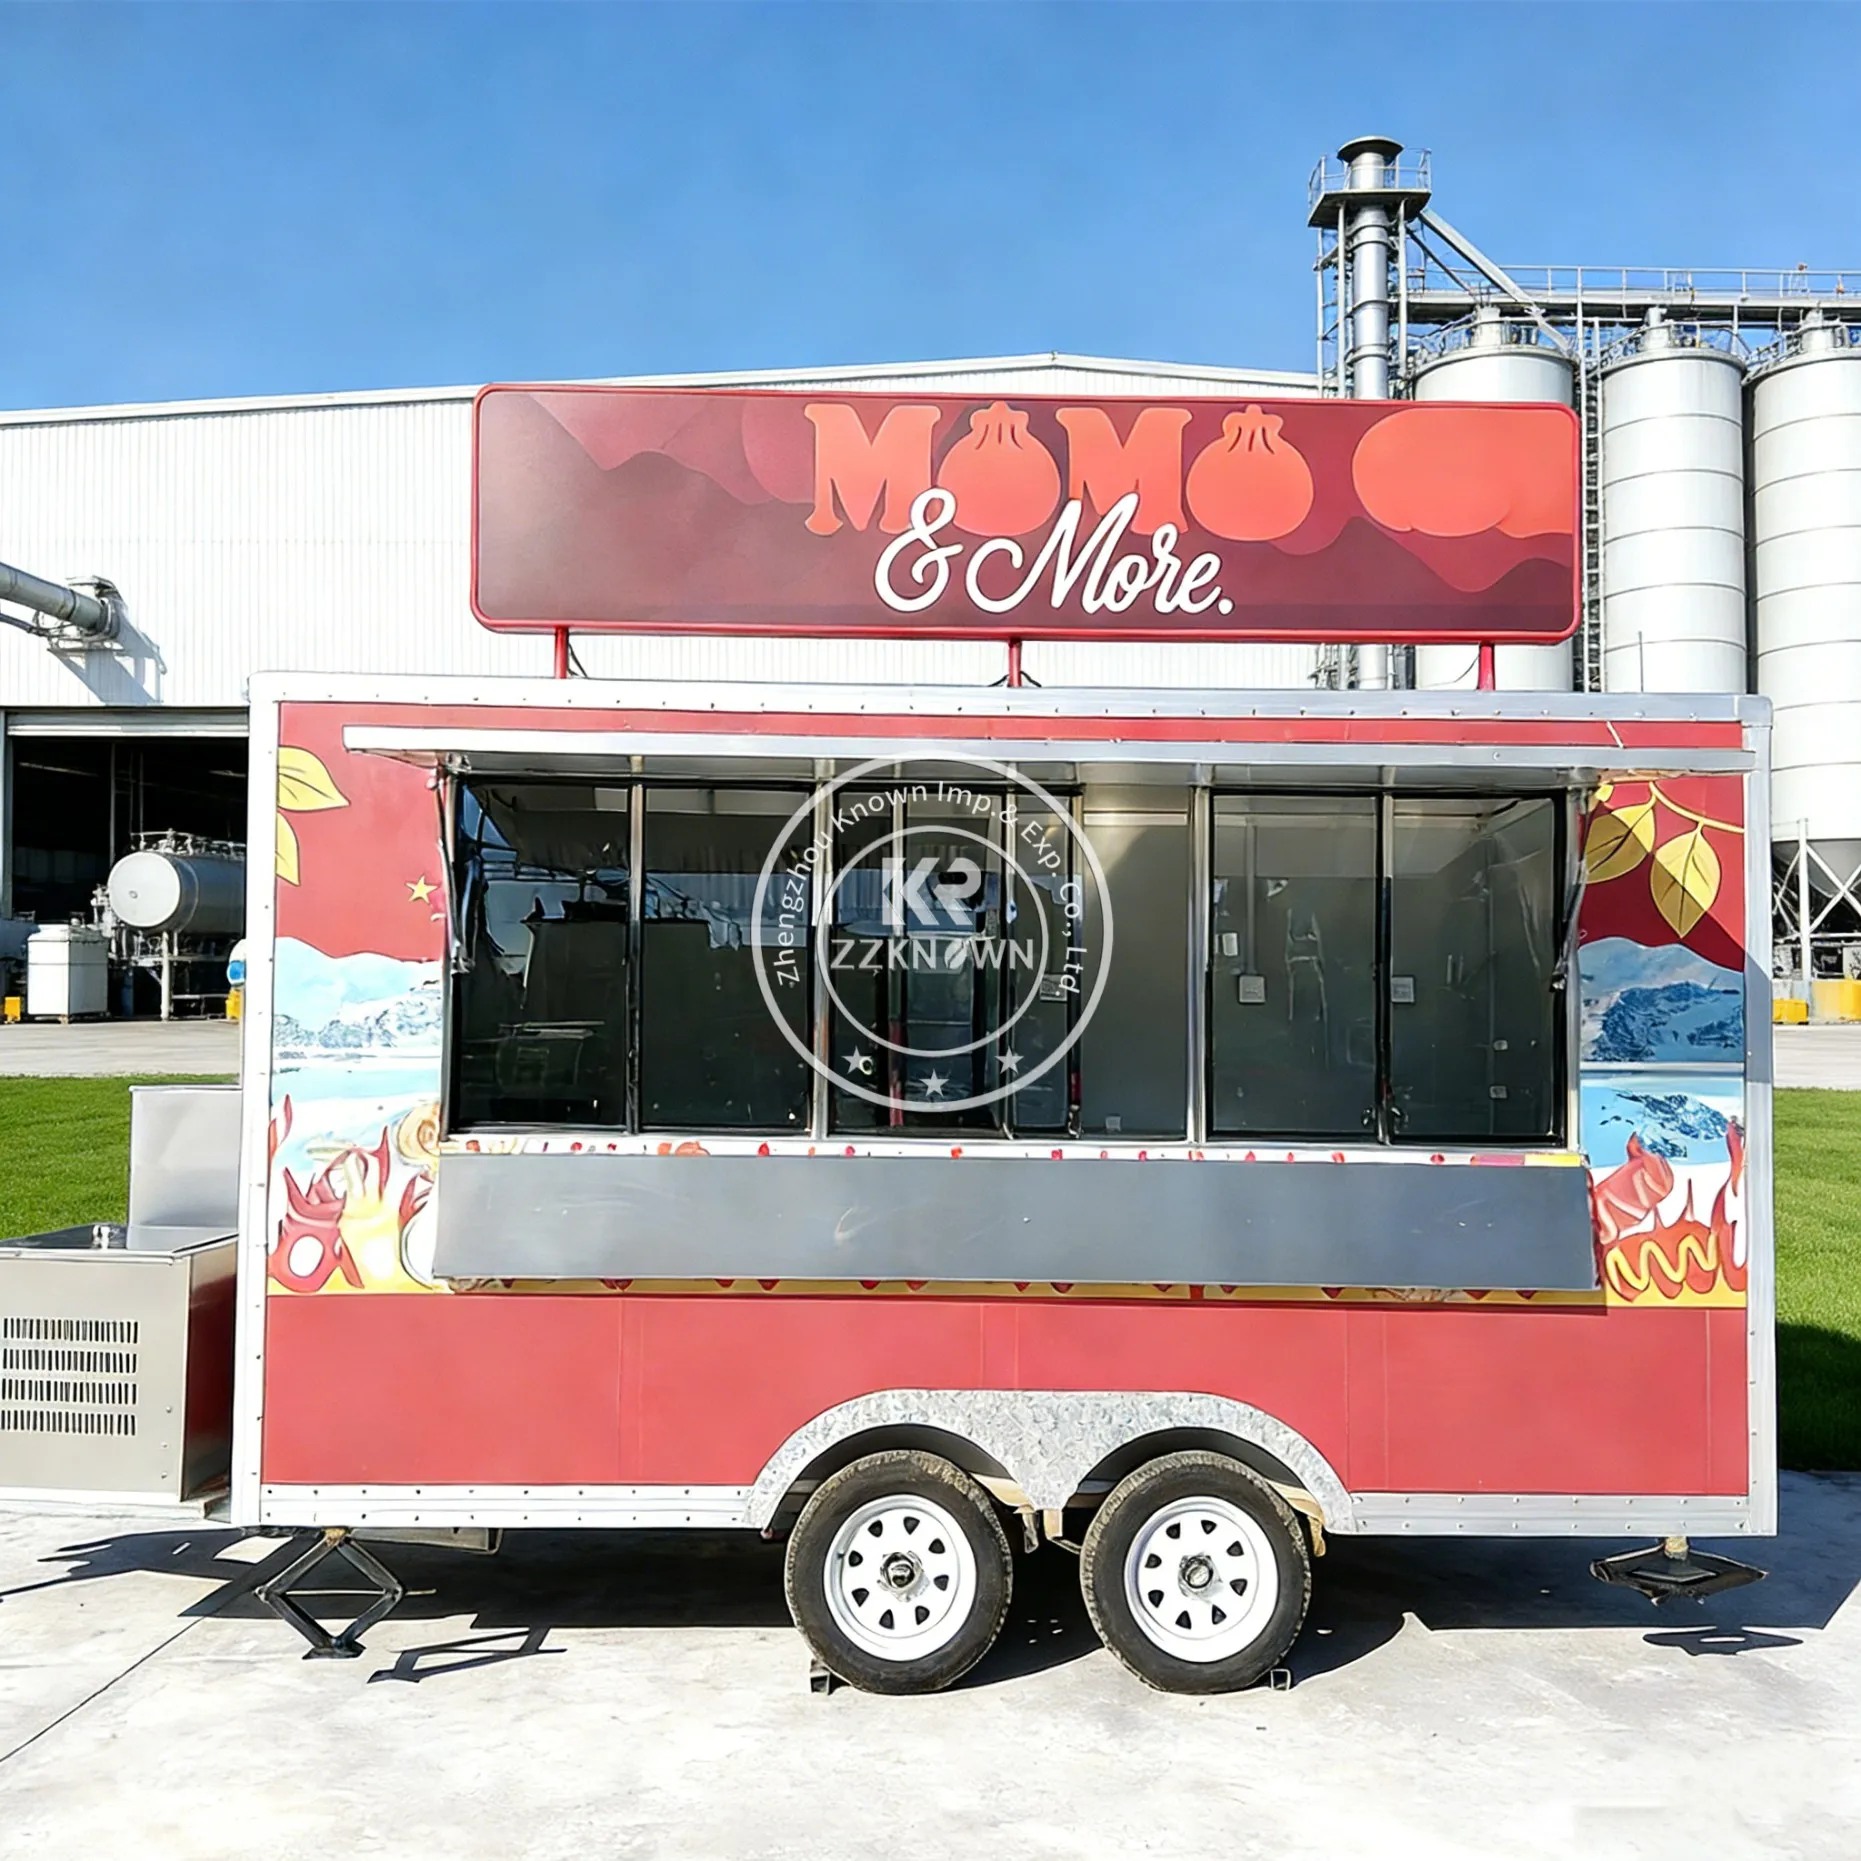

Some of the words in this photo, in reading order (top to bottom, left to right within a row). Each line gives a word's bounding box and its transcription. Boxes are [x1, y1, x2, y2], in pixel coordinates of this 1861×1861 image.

[804, 401, 1314, 542] MOMO
[875, 488, 963, 612] &
[965, 493, 1235, 615] More.
